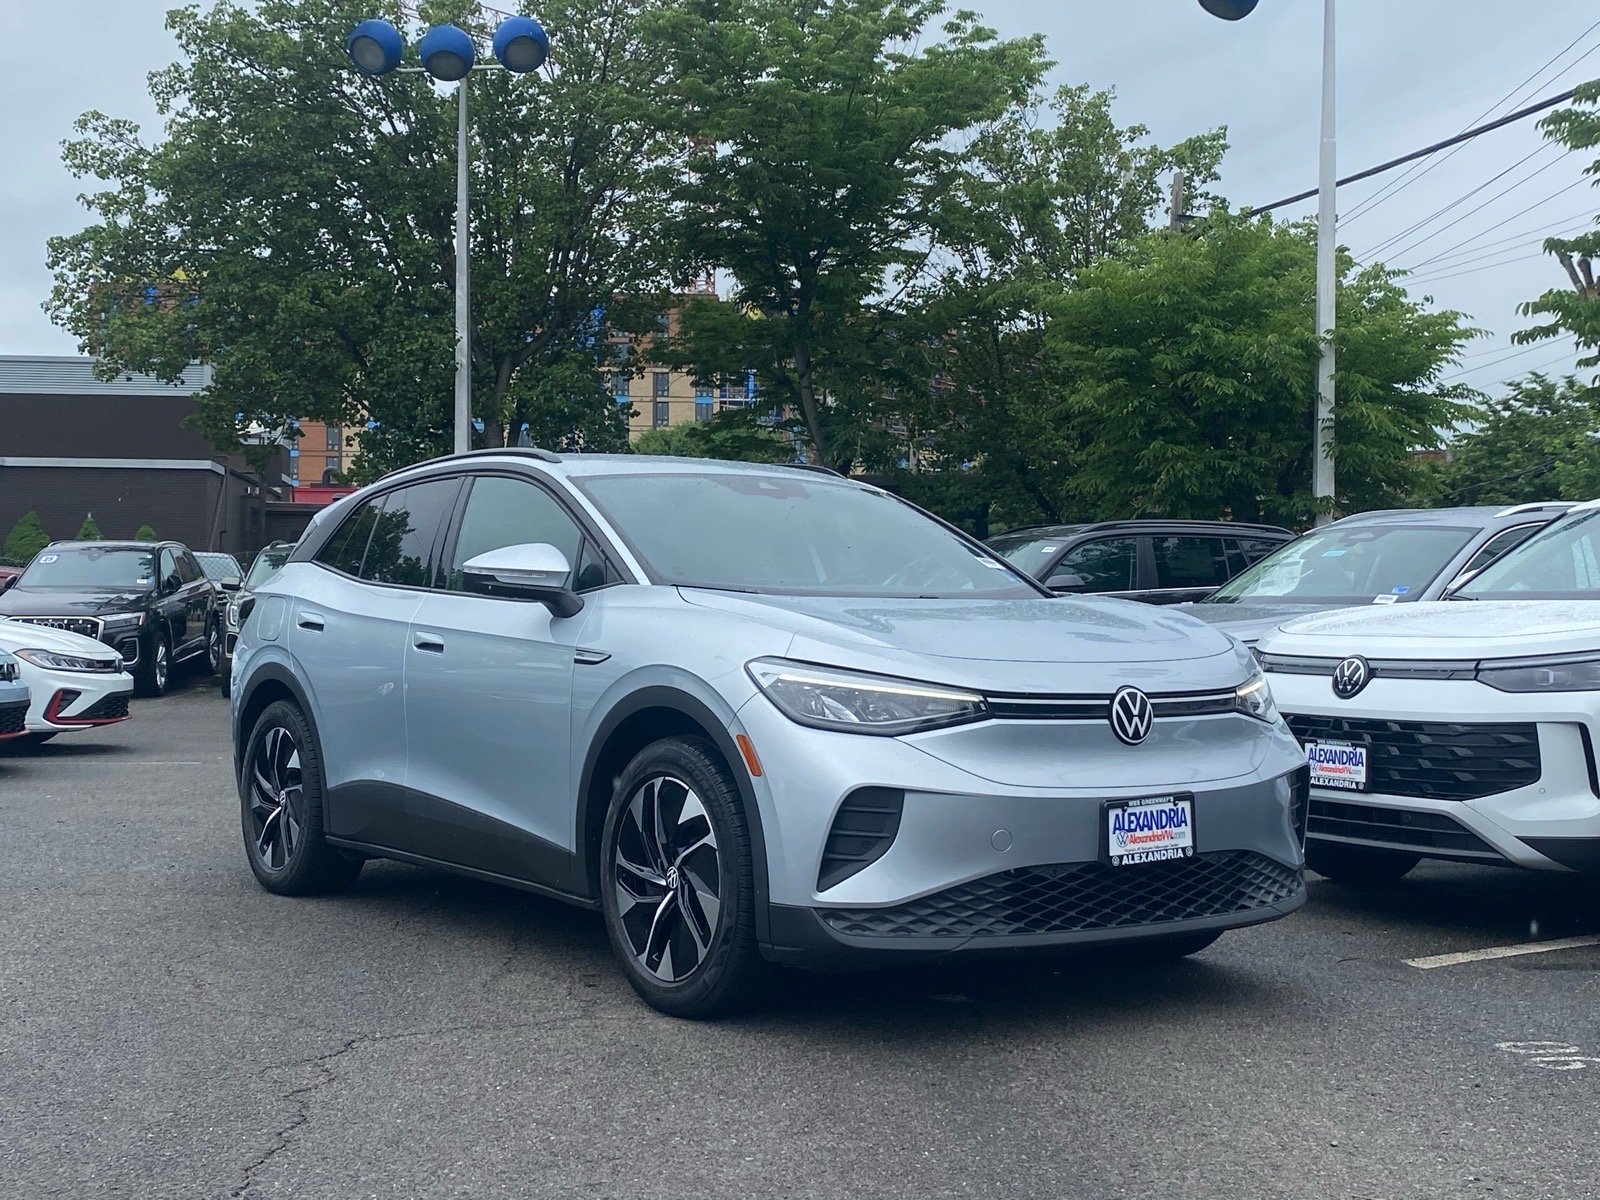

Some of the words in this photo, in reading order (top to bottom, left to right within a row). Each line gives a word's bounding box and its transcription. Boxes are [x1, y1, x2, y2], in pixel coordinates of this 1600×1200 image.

[1112, 688, 1154, 744] VW
[1308, 747, 1364, 767] ALEXANDRIA
[1310, 776, 1357, 789] ALEXANDRIA
[1112, 807, 1188, 834] ALEXANDRIA
[1128, 830, 1186, 844] AlexandriaVW.com
[1122, 848, 1184, 866] ALEXANDRIA
